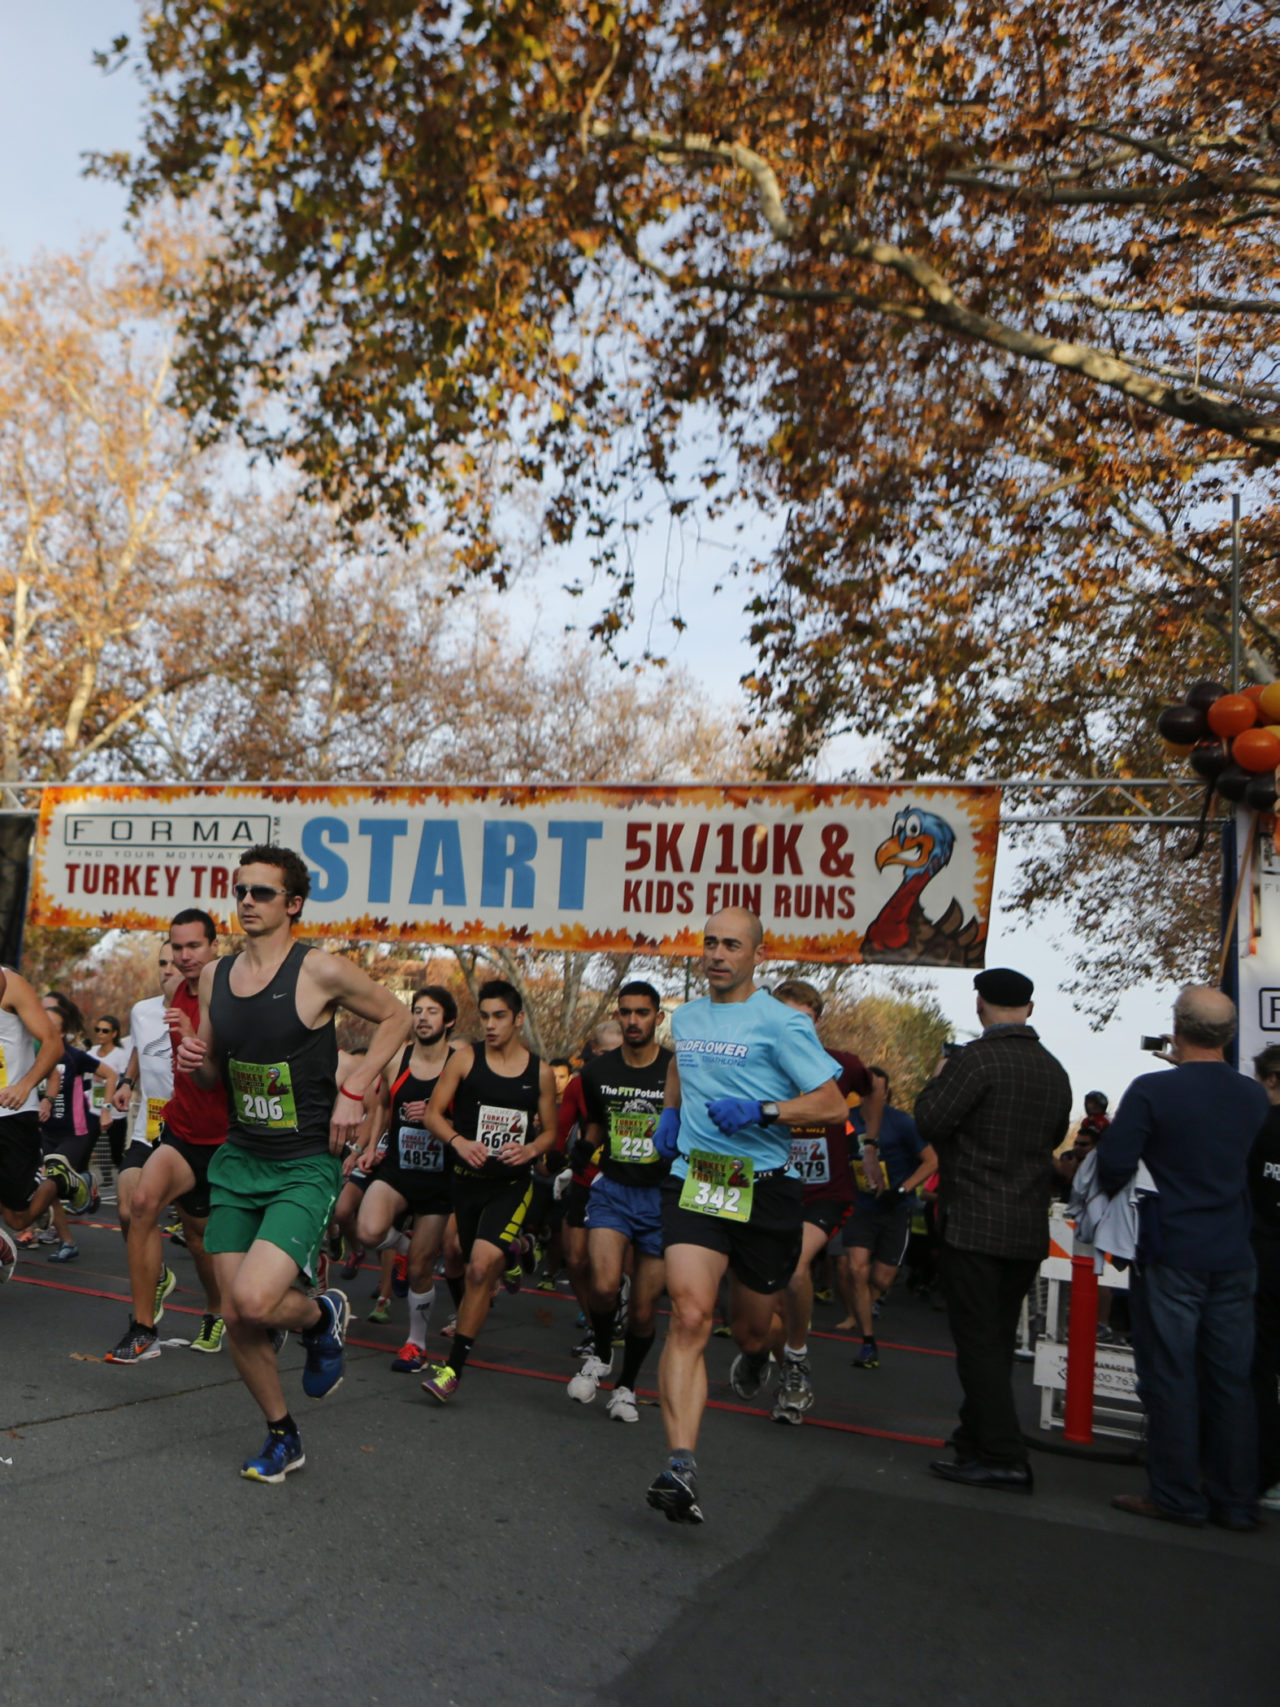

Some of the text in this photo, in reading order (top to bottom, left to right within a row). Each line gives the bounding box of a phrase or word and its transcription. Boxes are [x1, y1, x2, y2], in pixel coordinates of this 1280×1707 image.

[72, 819, 254, 842] FORMA
[67, 850, 104, 858] FIND
[114, 850, 155, 859] YOUR
[625, 822, 856, 878] 5K/10K &
[301, 816, 604, 911] START
[65, 863, 239, 899] TURKEY TR
[622, 879, 856, 920] KIDS FUN RUNS
[600, 1084, 618, 1095] The
[242, 1093, 284, 1120] 206
[482, 1113, 510, 1122] TURKEY
[481, 1123, 500, 1132] TROT
[403, 1149, 441, 1168] 4857
[620, 1136, 654, 1158] 229
[694, 1181, 742, 1213] 342
